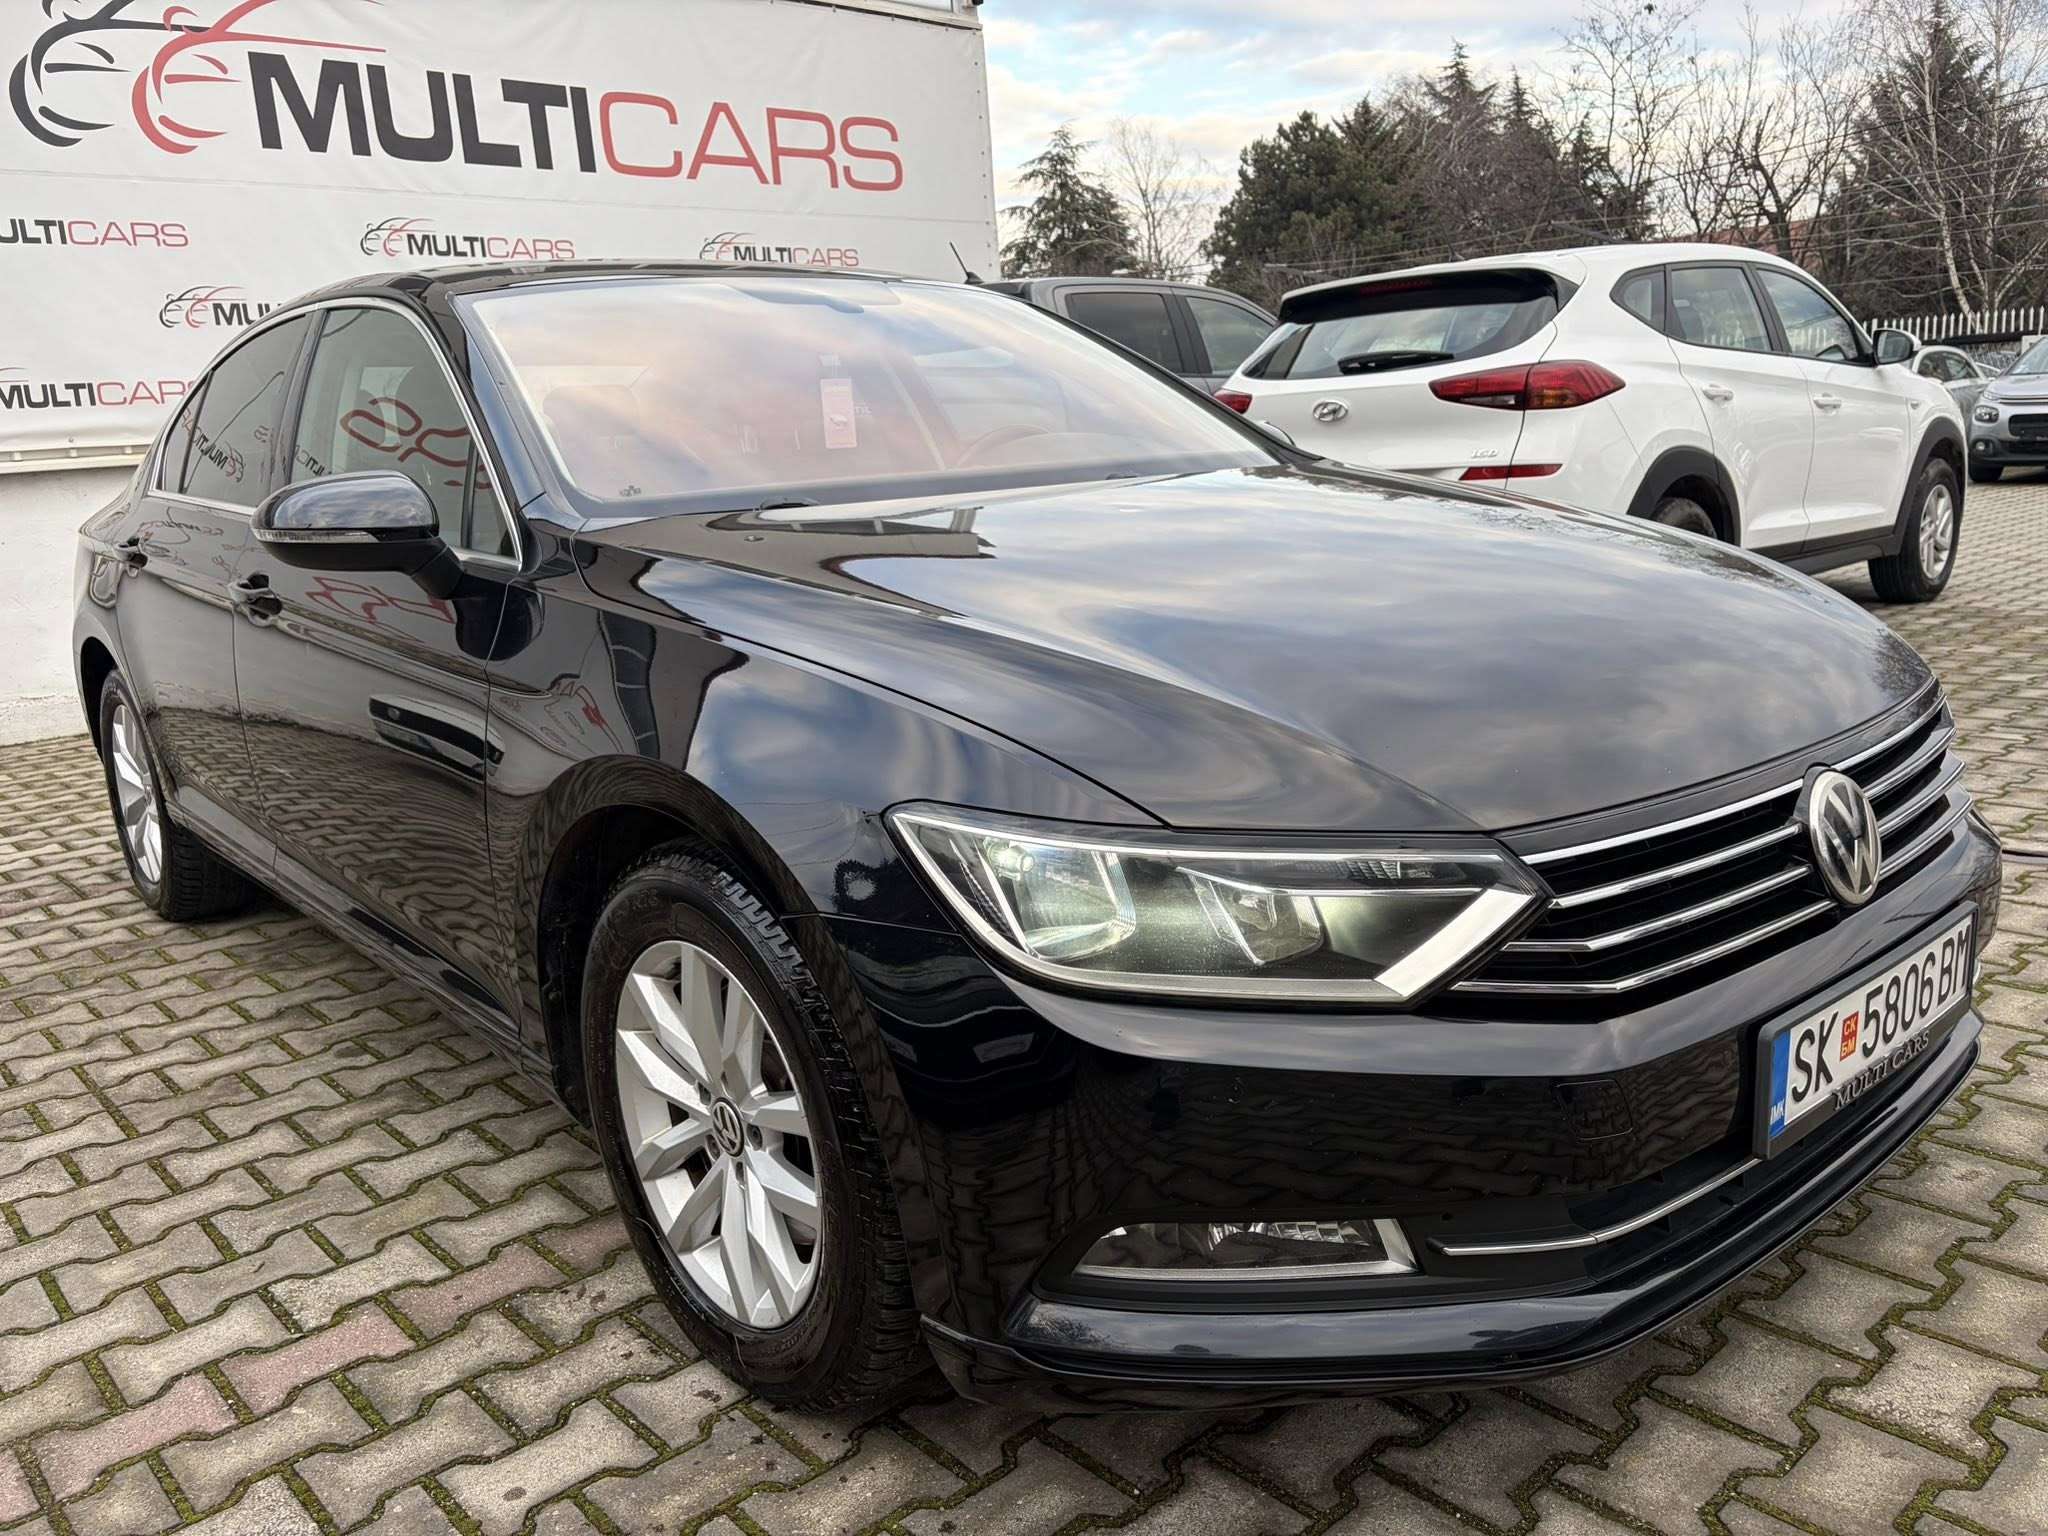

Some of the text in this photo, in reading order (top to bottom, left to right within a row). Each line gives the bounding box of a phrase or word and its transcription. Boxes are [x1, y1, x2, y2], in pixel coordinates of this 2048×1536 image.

[247, 51, 904, 192] MULTICARS
[0, 218, 188, 248] ULTICARS
[406, 233, 575, 259] MULTICARS
[733, 246, 859, 267] MULTICARS
[0, 381, 196, 409] MULTICAR
[1792, 1011, 1839, 1102] SK
[1833, 1031, 1929, 1111] MULTI CARS
